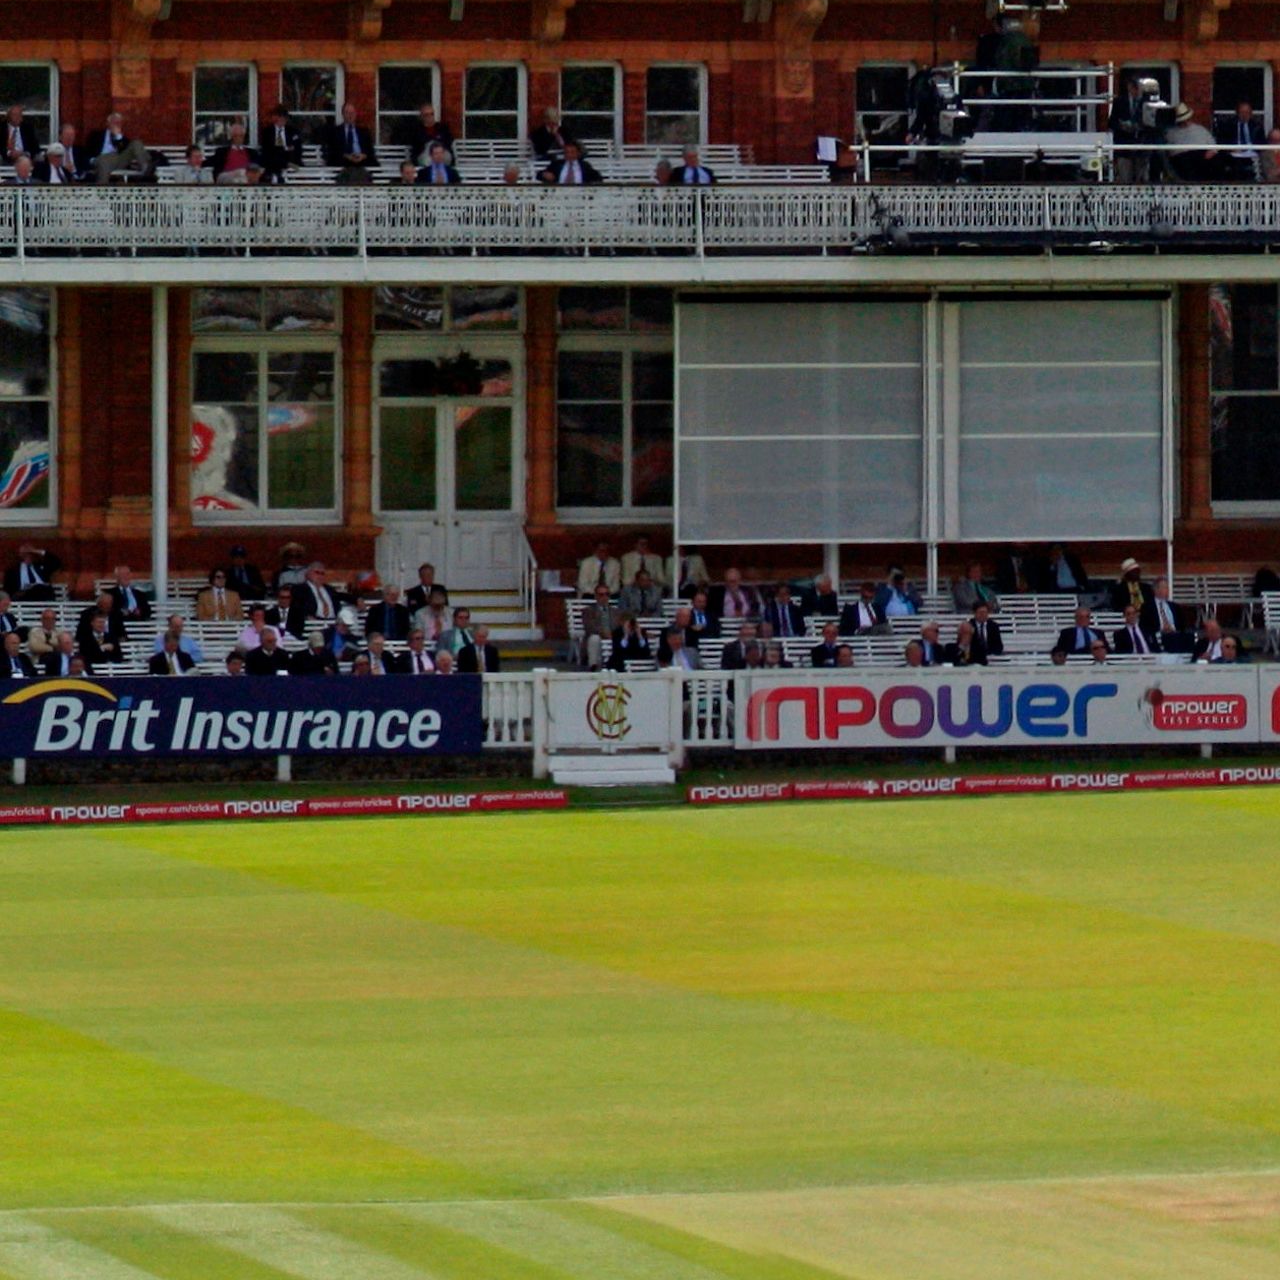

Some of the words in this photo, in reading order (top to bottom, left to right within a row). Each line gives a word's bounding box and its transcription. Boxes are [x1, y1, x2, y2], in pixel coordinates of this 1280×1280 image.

[746, 682, 1119, 741] npower
[1162, 701, 1239, 714] npower
[35, 695, 159, 751] Brit
[171, 696, 442, 751] Insurance
[1163, 716, 1190, 724] TEST
[1197, 716, 1239, 724] SERIES
[882, 777, 962, 794] npower
[1051, 773, 1129, 788] npower
[51, 805, 131, 820] npower
[224, 799, 304, 814] npower
[397, 794, 476, 809] npower
